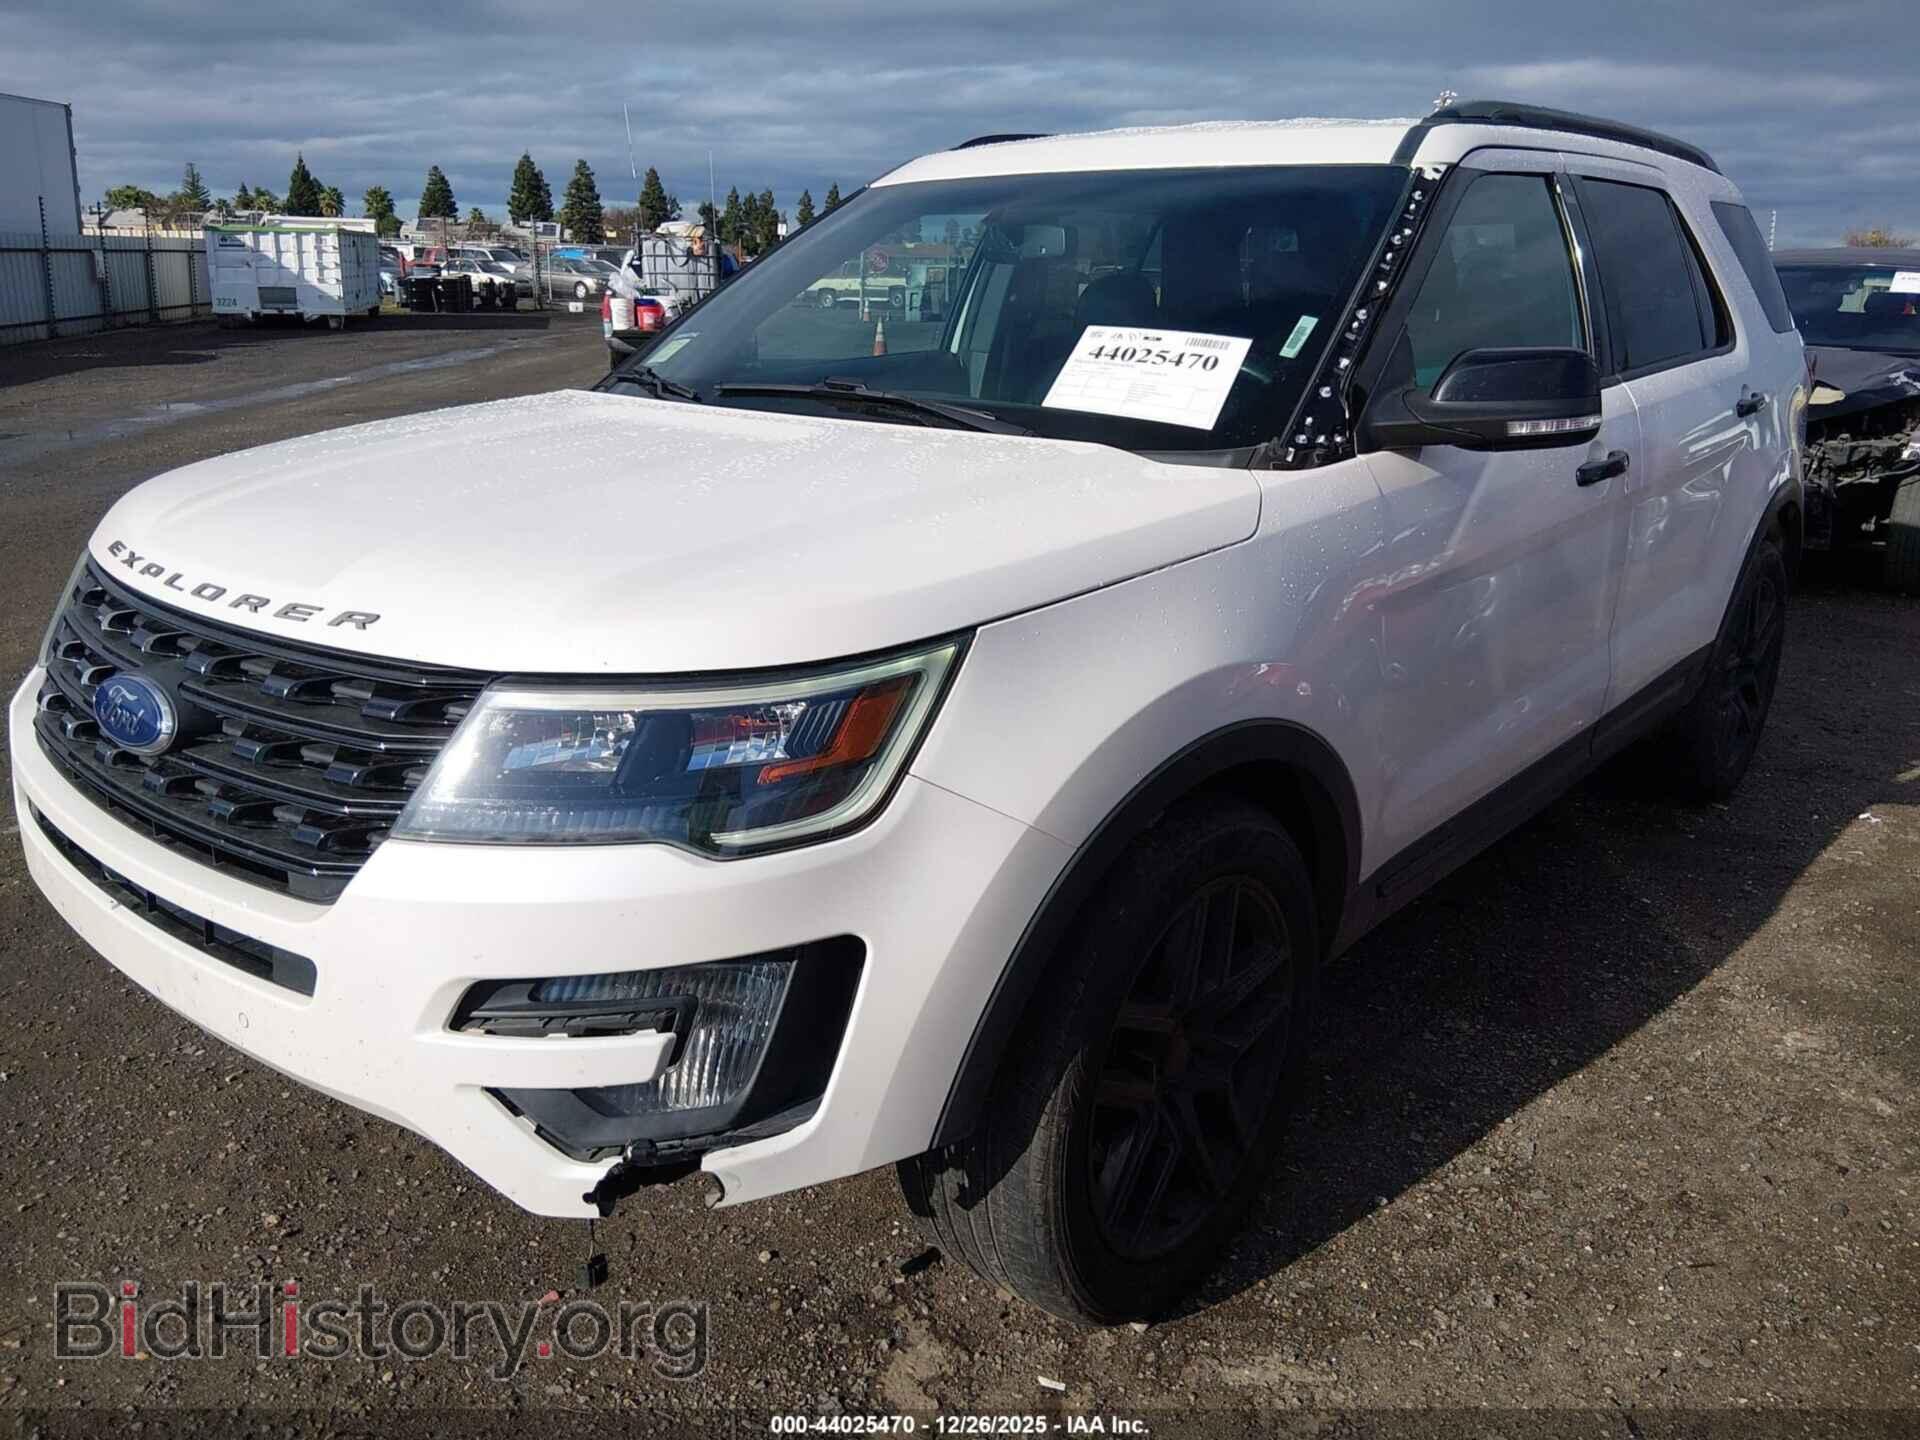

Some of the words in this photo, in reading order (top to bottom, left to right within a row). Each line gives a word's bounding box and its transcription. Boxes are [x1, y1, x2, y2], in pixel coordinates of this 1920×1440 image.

[1088, 344, 1219, 371] 44025470
[107, 540, 381, 630] EXPLORER
[100, 685, 144, 735] Ford
